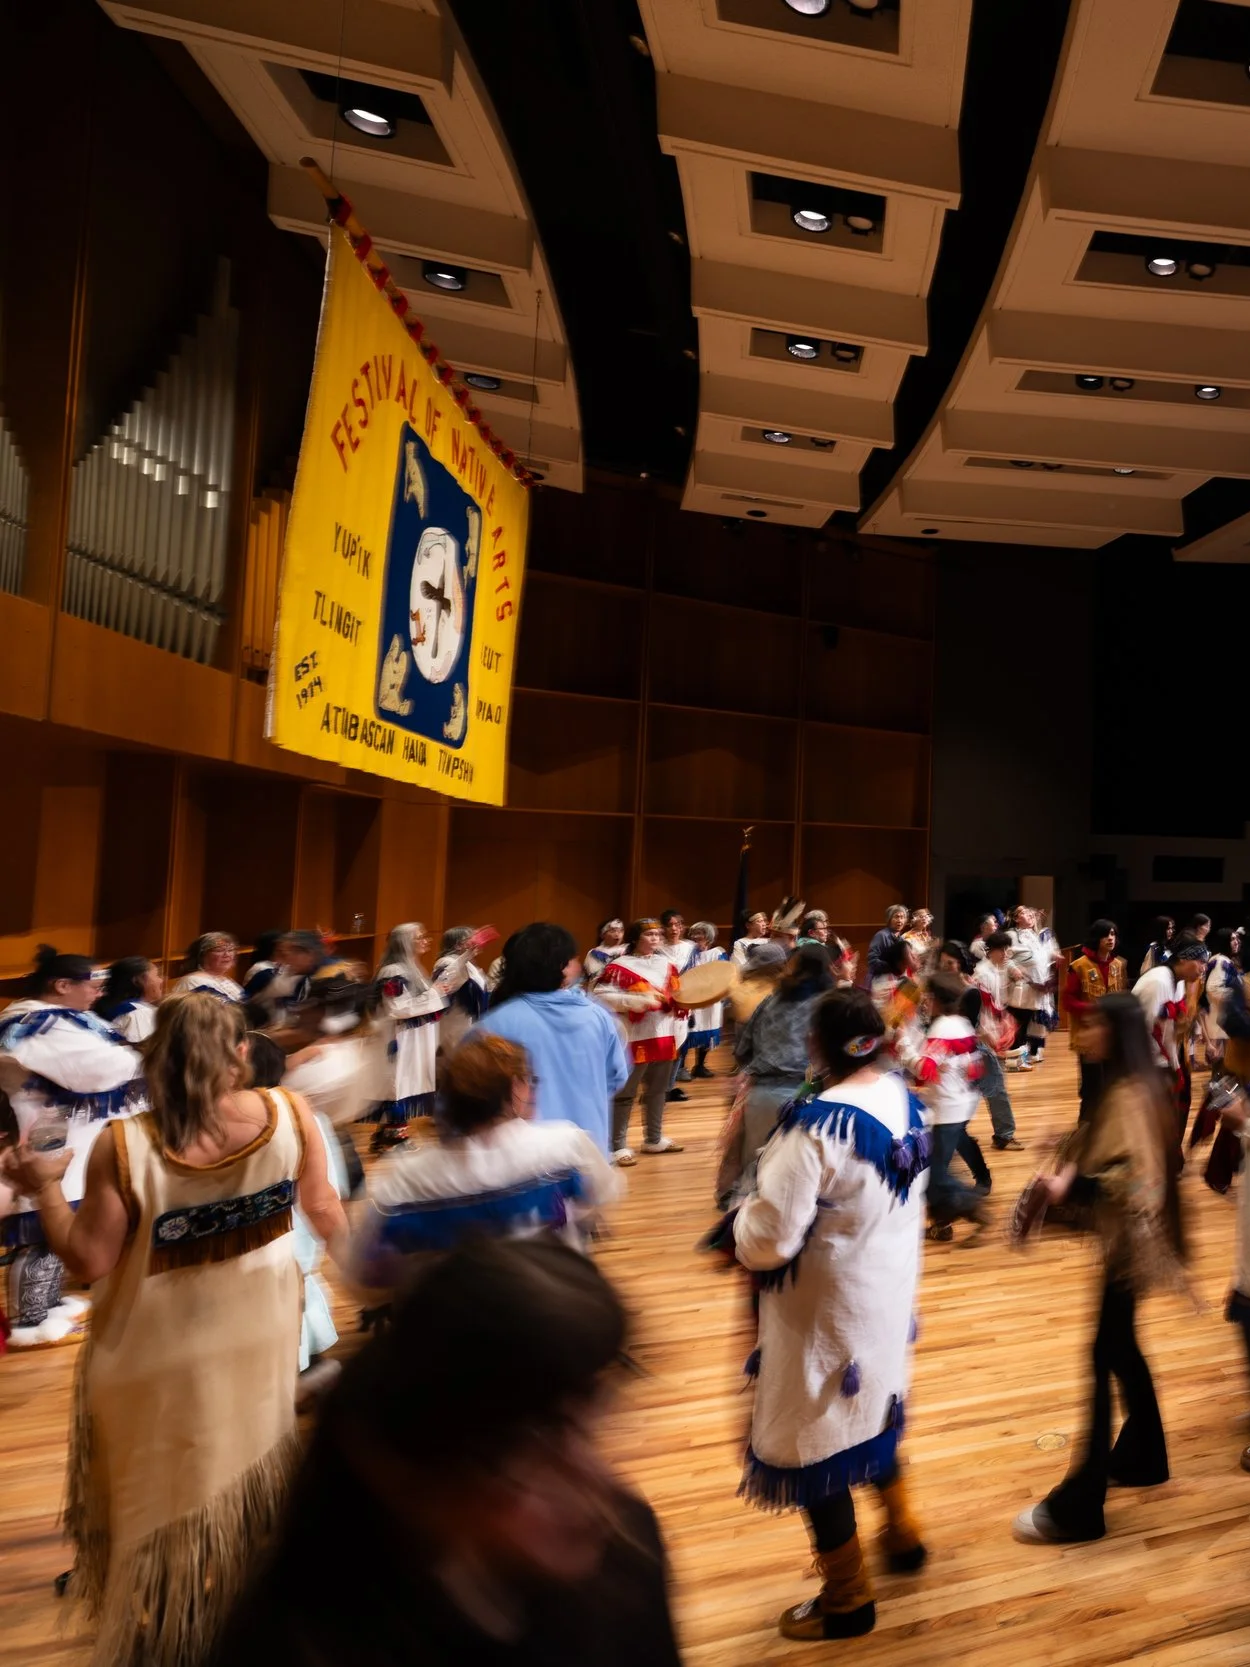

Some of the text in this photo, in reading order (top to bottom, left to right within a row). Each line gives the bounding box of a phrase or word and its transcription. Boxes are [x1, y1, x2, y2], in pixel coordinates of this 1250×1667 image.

[330, 353, 513, 622] FESTIVAL OF NATIVE ARTS
[334, 521, 371, 580] YUP'IK
[313, 590, 363, 647] TLINGIT
[295, 675, 323, 710] 1974
